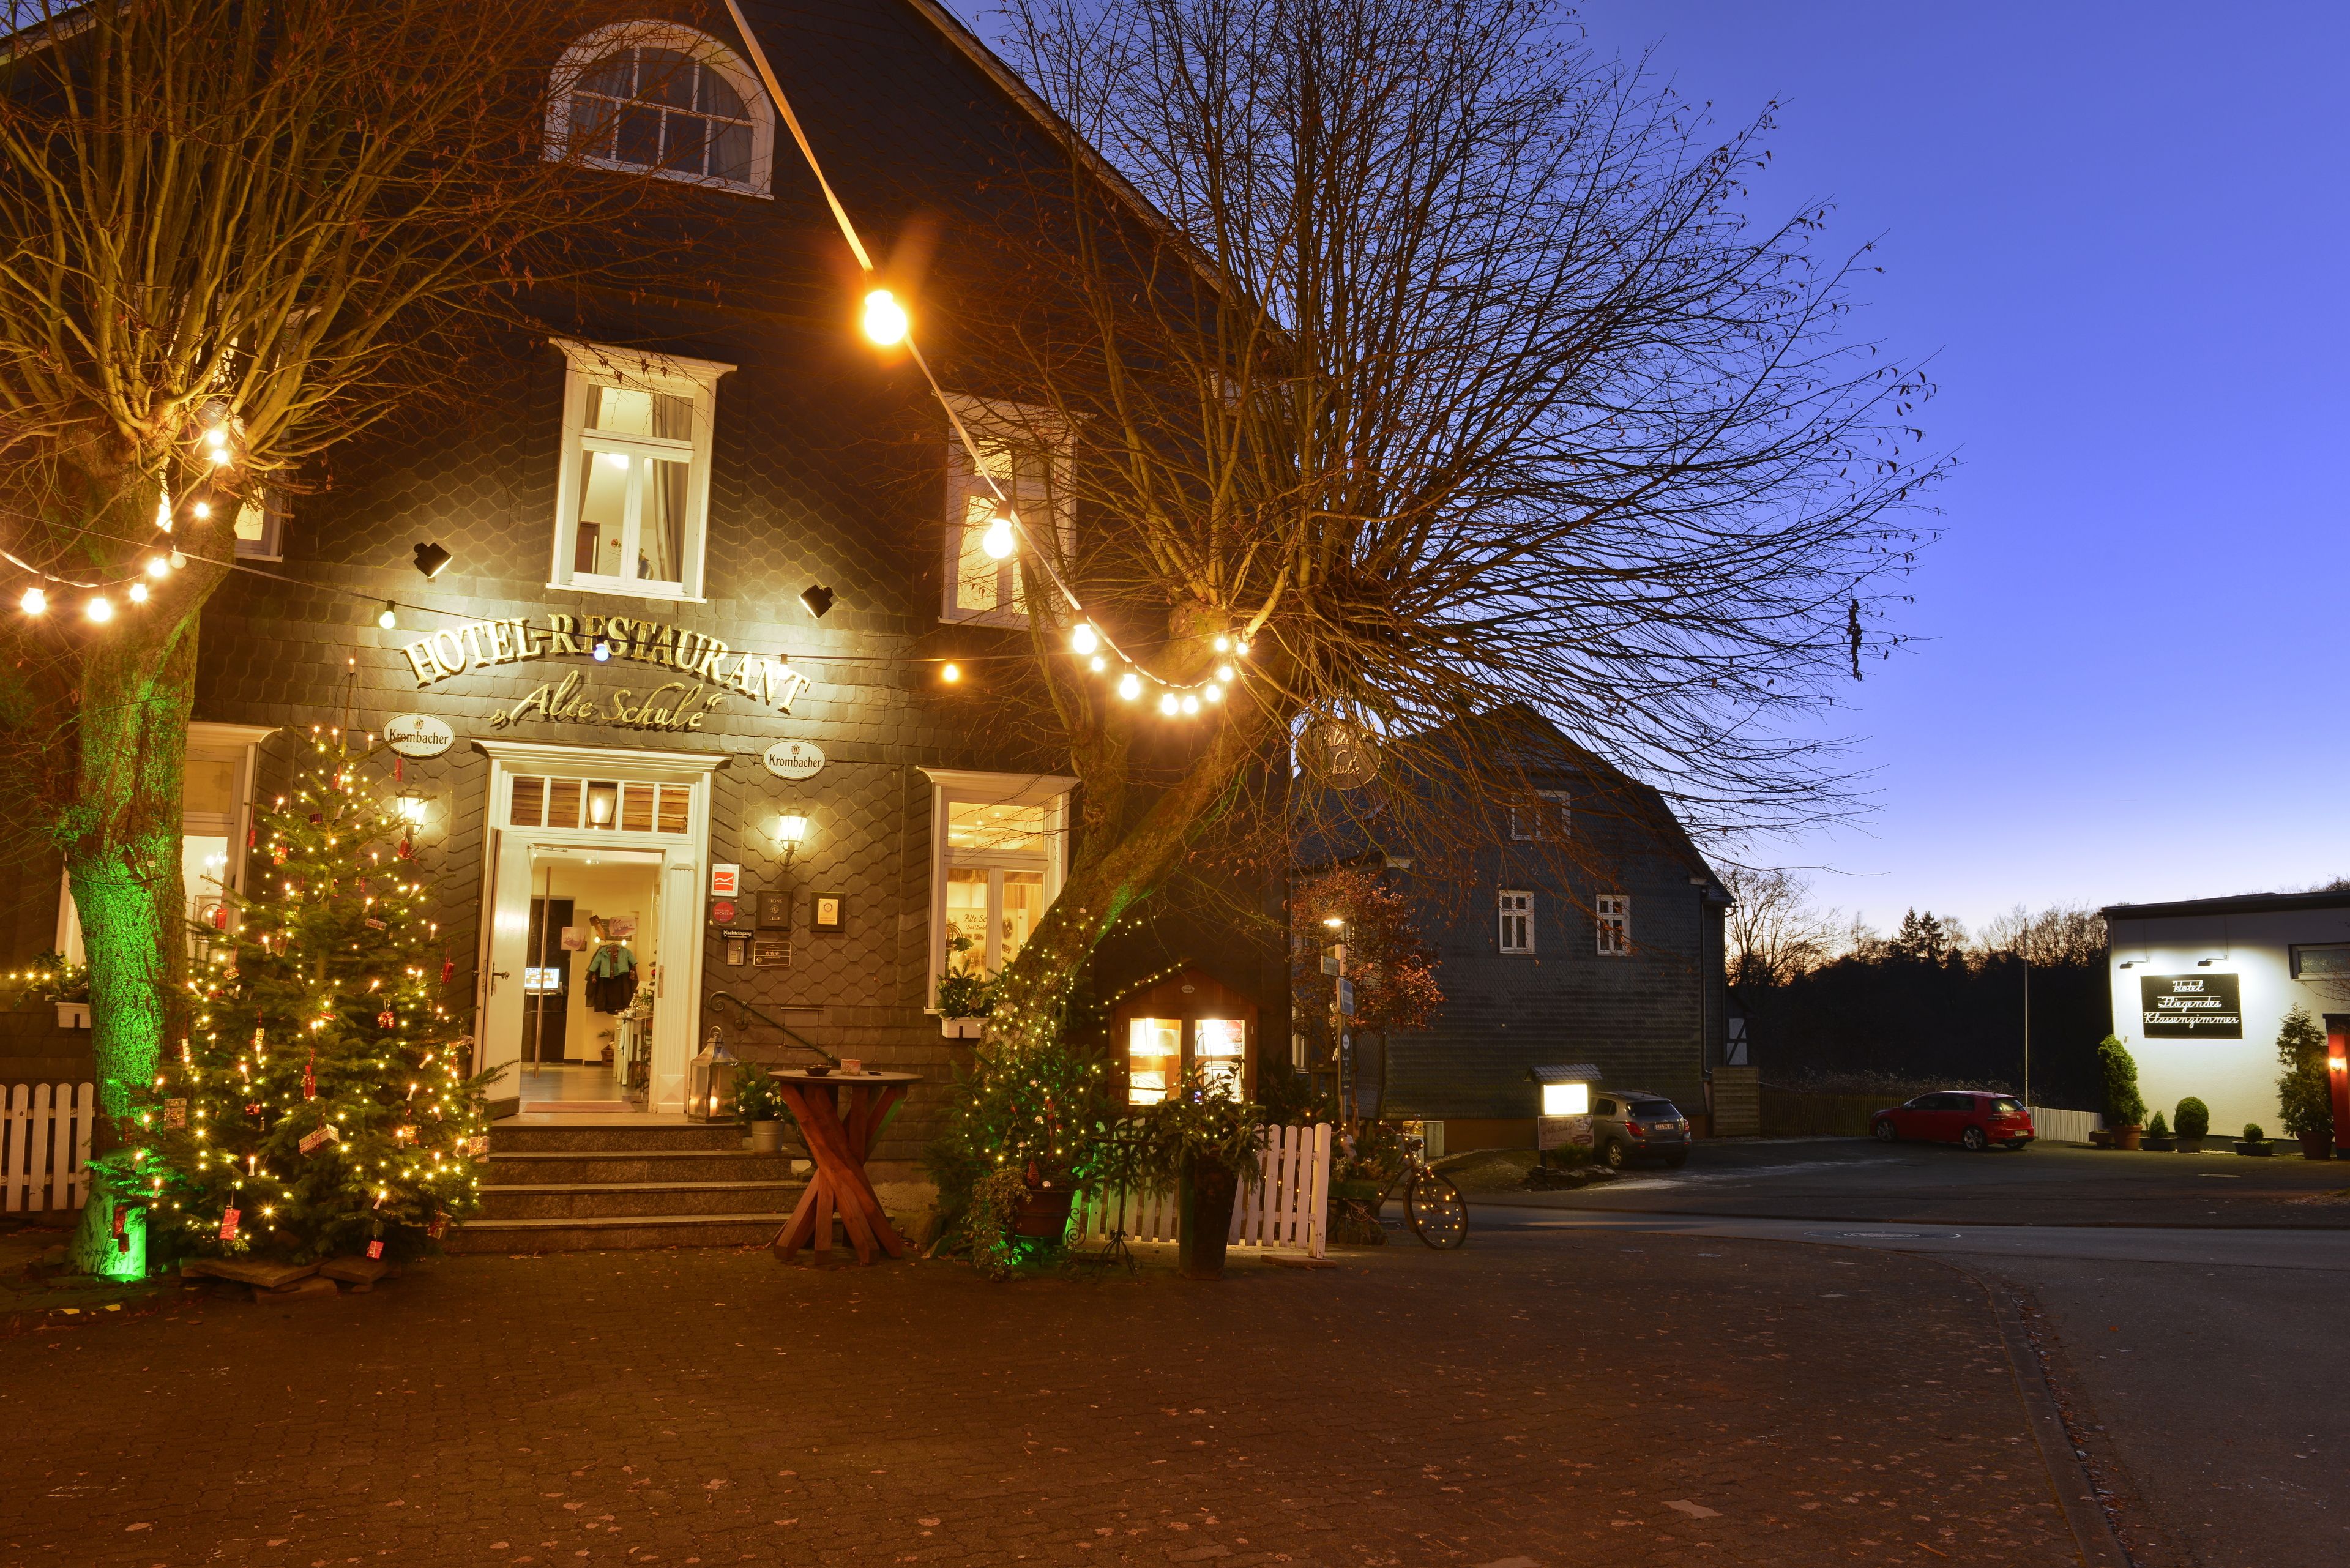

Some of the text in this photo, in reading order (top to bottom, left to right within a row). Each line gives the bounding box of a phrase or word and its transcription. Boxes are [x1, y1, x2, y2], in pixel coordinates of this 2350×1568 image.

[401, 613, 810, 711] HOTEL-RESTAURANT
[389, 728, 449, 744] Krombacher
[769, 753, 821, 768] Krombacher
[960, 914, 977, 922] Alte
[2173, 980, 2204, 992] Hotel
[2157, 996, 2222, 1012] Fliegendes
[2144, 1012, 2239, 1029] Klassenzimmer
